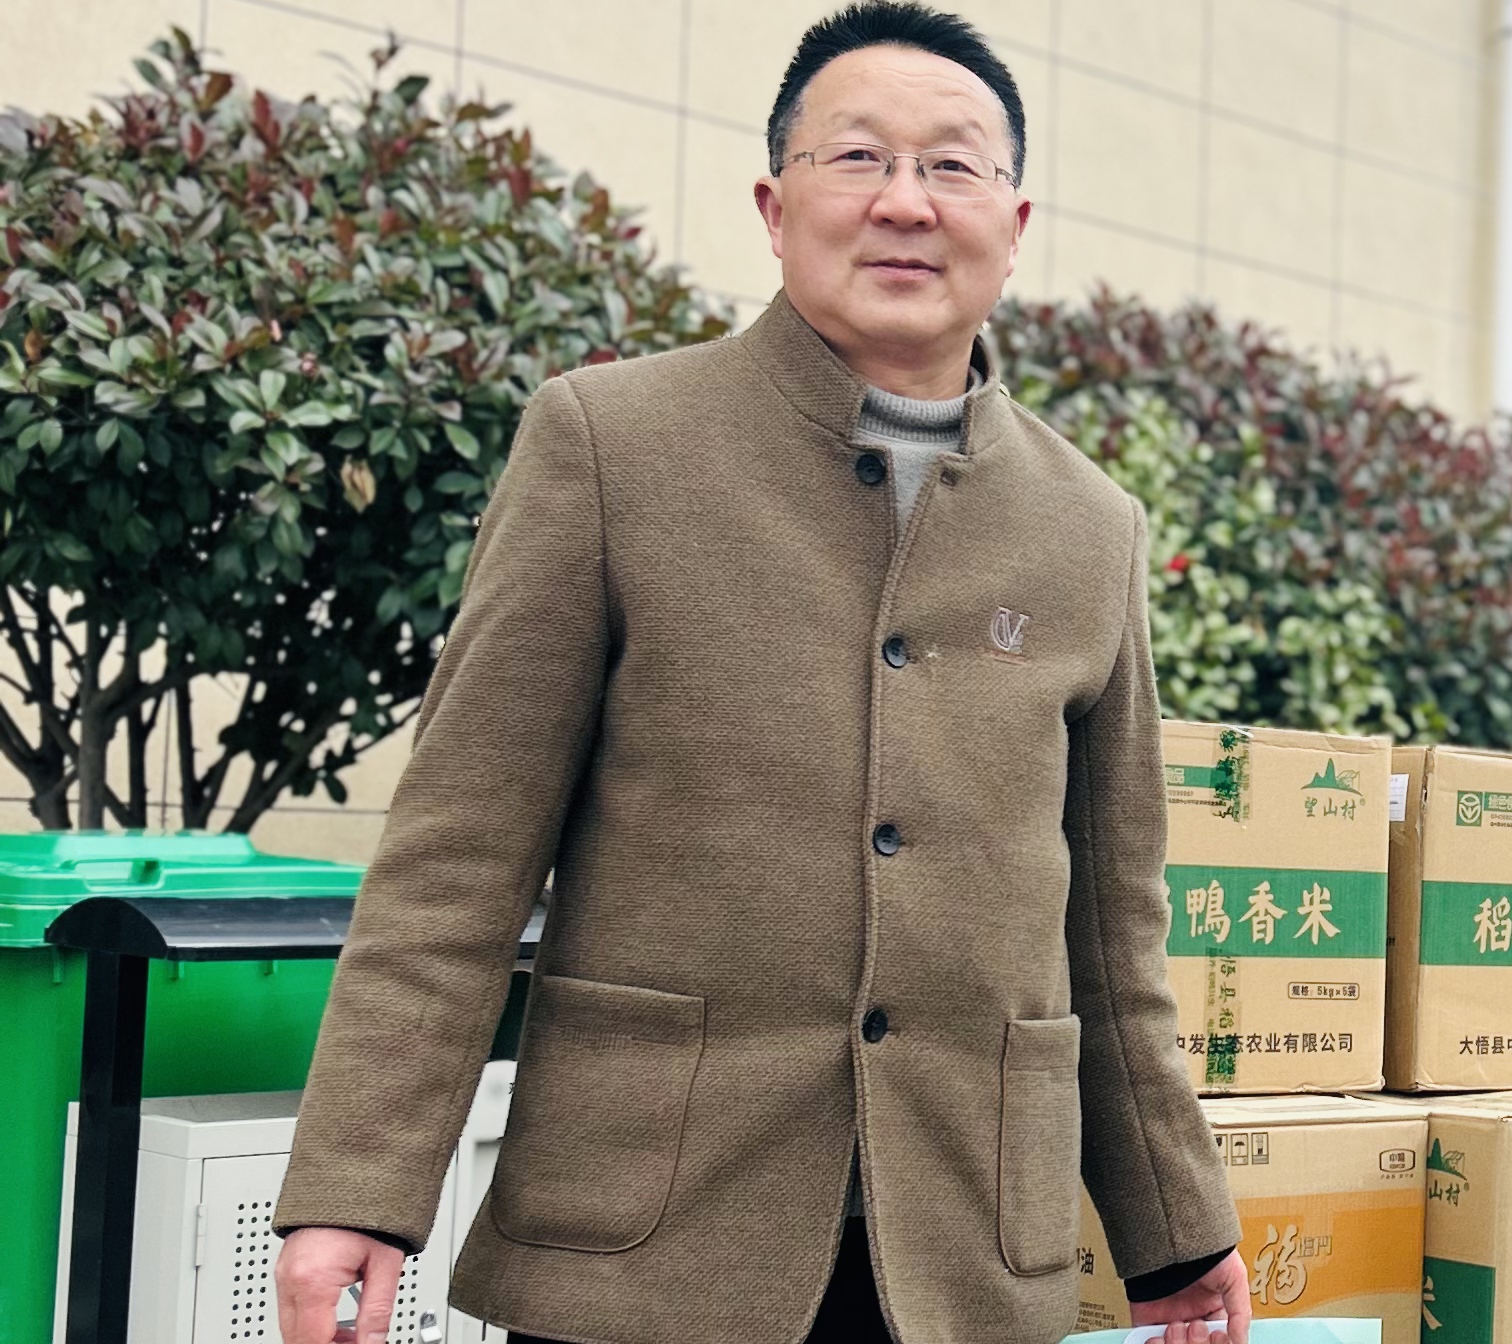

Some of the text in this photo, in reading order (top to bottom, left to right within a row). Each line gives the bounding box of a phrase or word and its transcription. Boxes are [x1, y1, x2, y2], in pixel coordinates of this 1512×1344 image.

[1304, 796, 1357, 821] 望山村
[1168, 880, 1342, 945] 鴨香米
